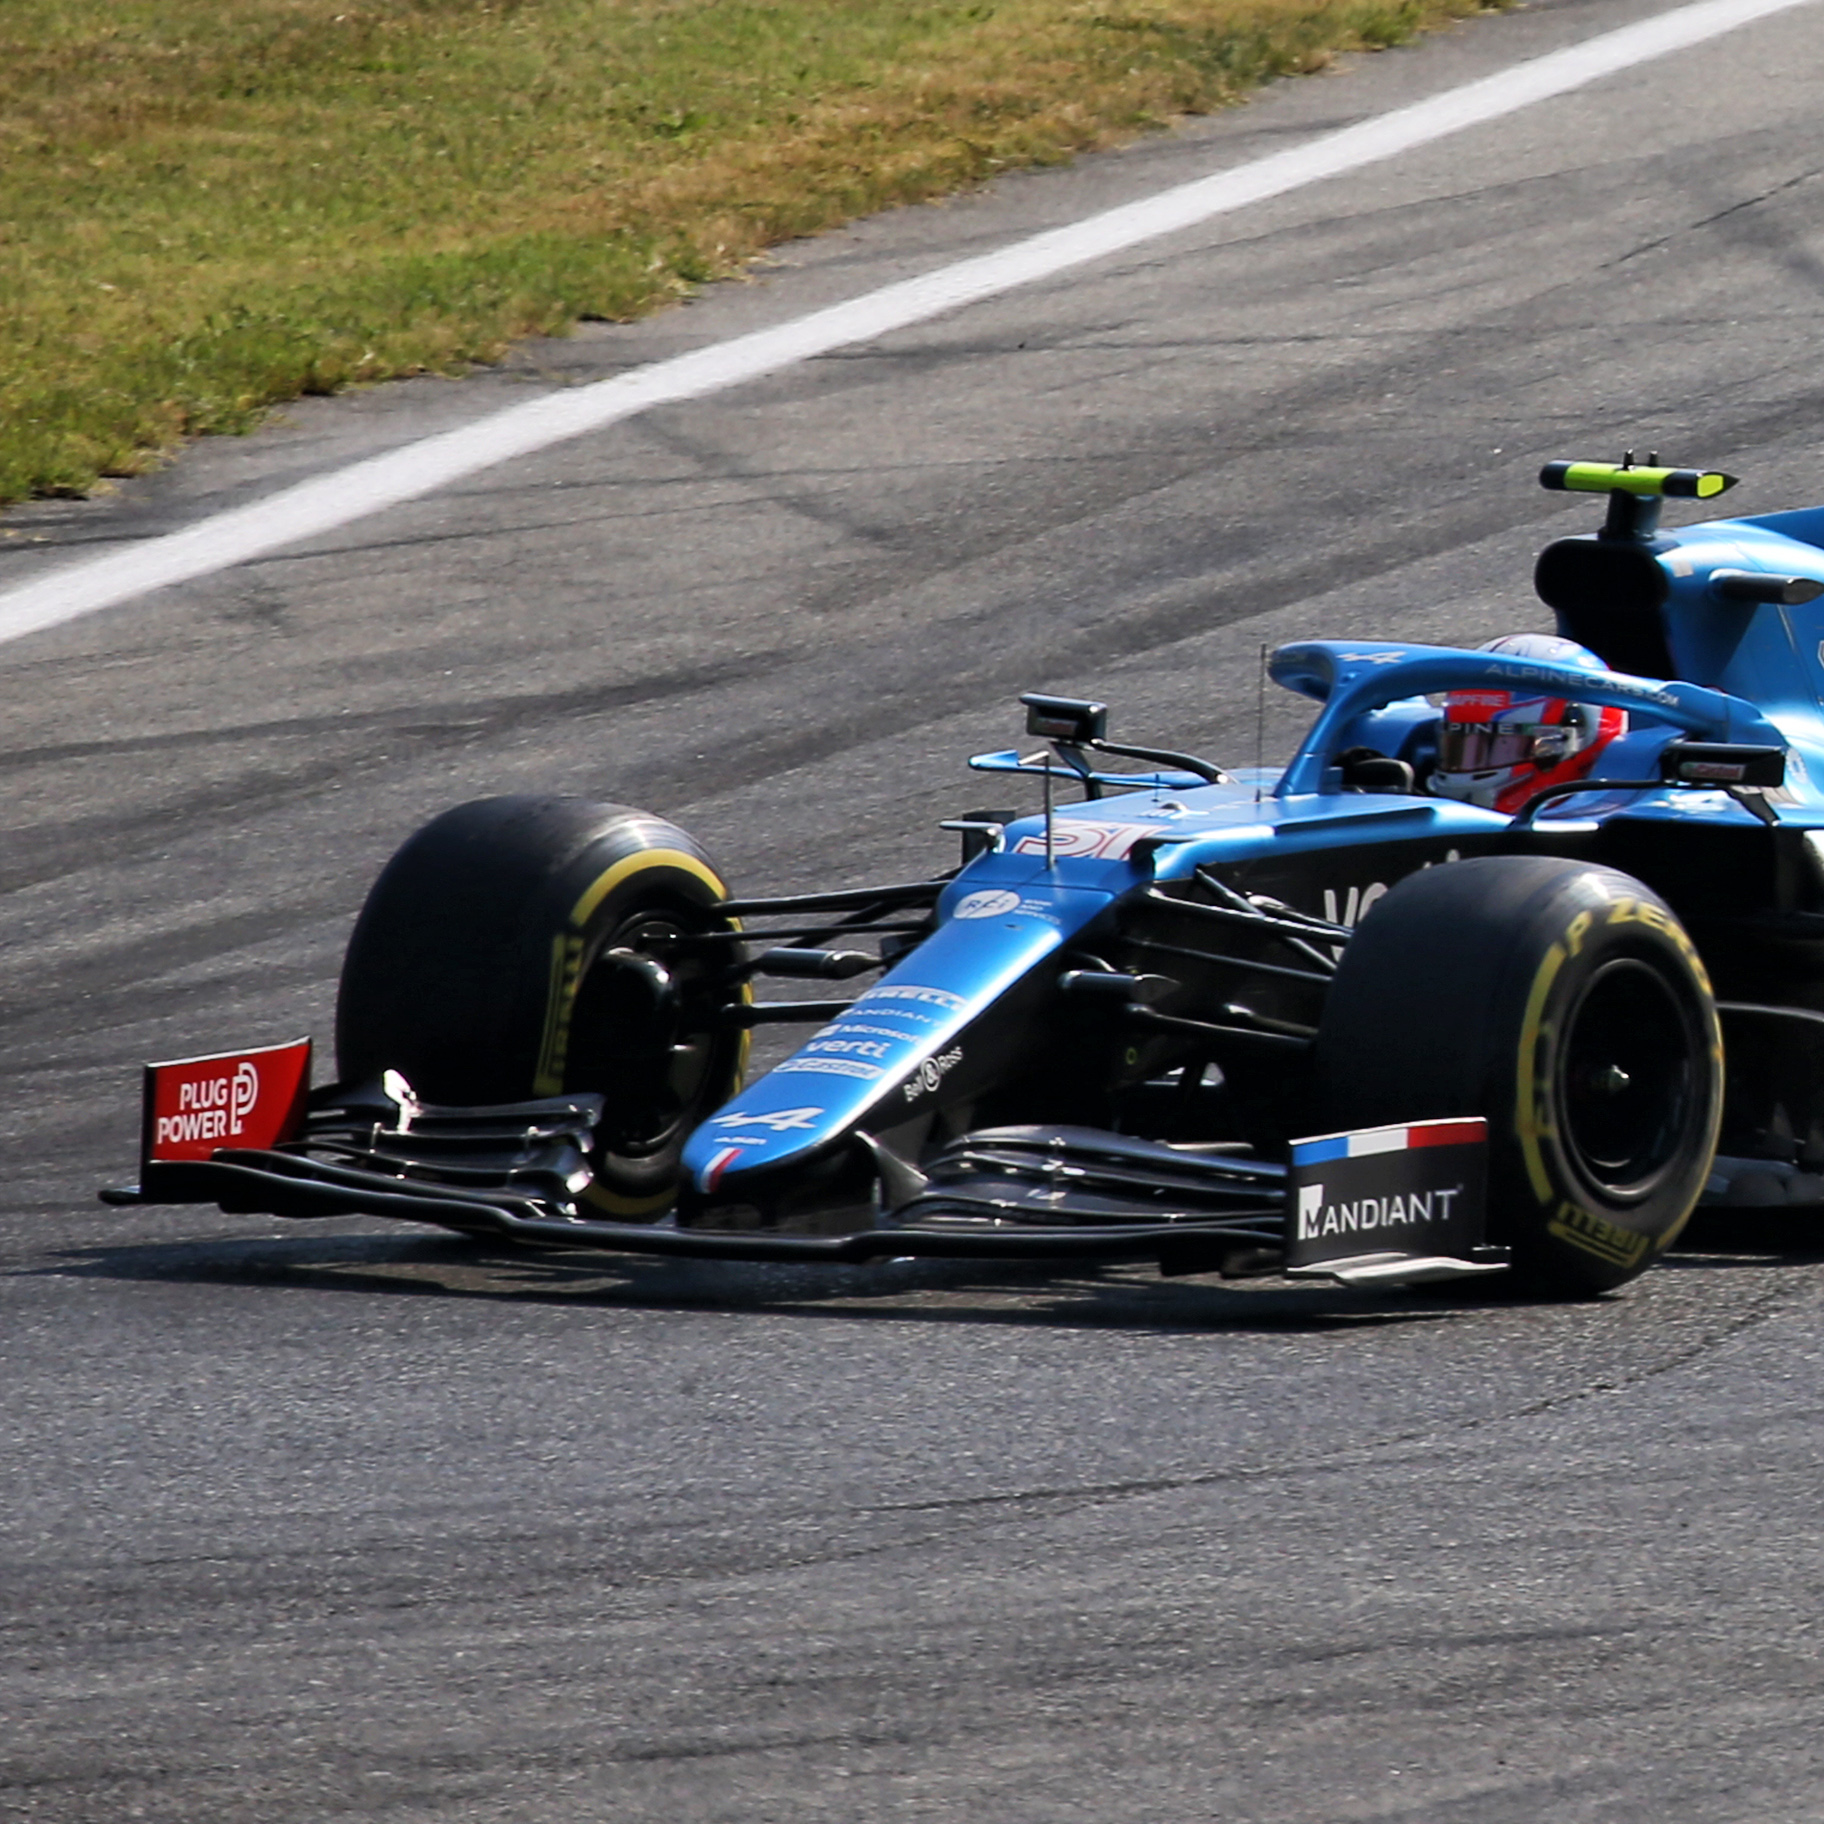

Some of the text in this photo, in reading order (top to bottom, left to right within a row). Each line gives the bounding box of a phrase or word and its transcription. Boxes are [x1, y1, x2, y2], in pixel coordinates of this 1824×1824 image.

[805, 1039, 892, 1059] verti
[179, 1077, 229, 1111] PLUG
[156, 1109, 227, 1145] POWER
[1297, 1183, 1459, 1240] MANDIANT
